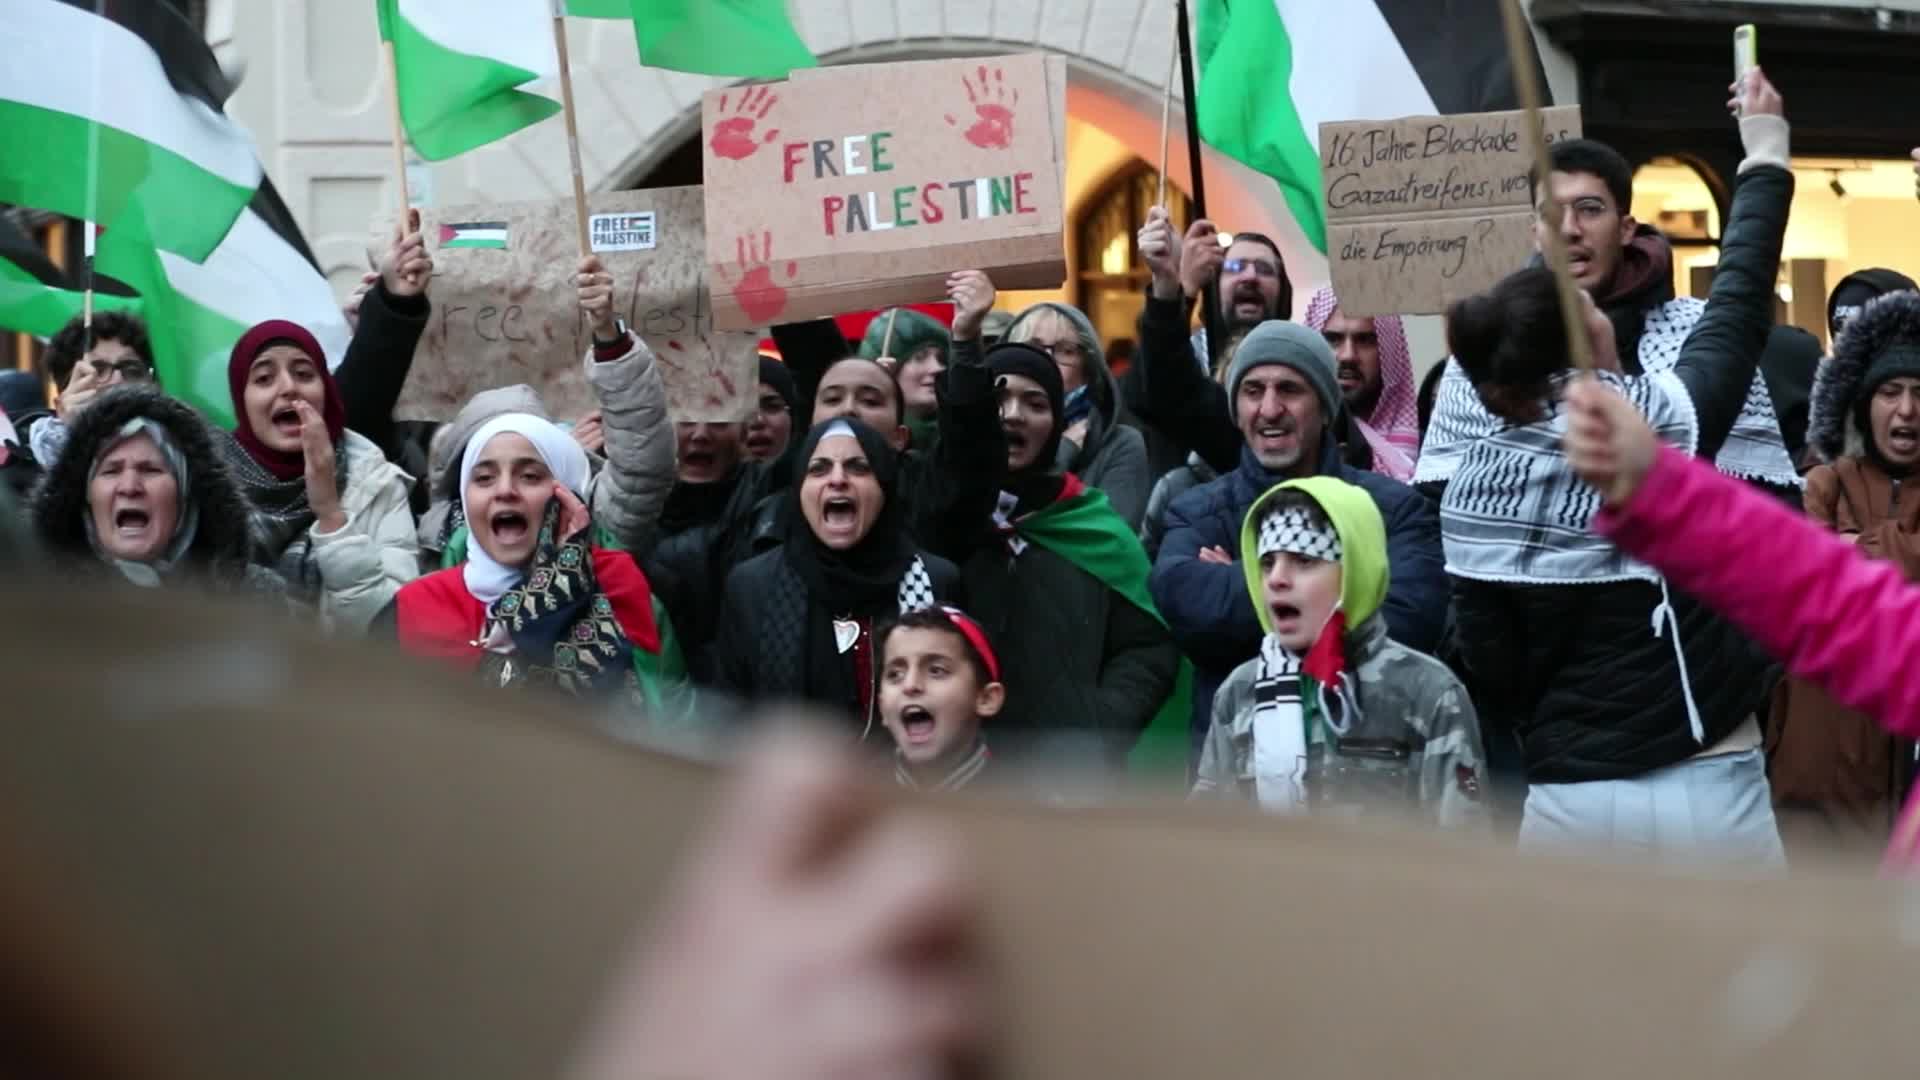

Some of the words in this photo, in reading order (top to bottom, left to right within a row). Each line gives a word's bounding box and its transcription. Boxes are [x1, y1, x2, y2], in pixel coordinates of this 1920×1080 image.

[783, 132, 893, 183] FREE
[1325, 132, 1354, 168] 16
[1361, 128, 1417, 168] Jahre
[1421, 118, 1518, 159] Blockade
[823, 172, 1037, 237] PALESTINE
[1327, 167, 1495, 210] Gazastreifens,
[593, 217, 626, 232] FREE
[593, 231, 650, 245] PALESTINE
[1340, 229, 1367, 261] die
